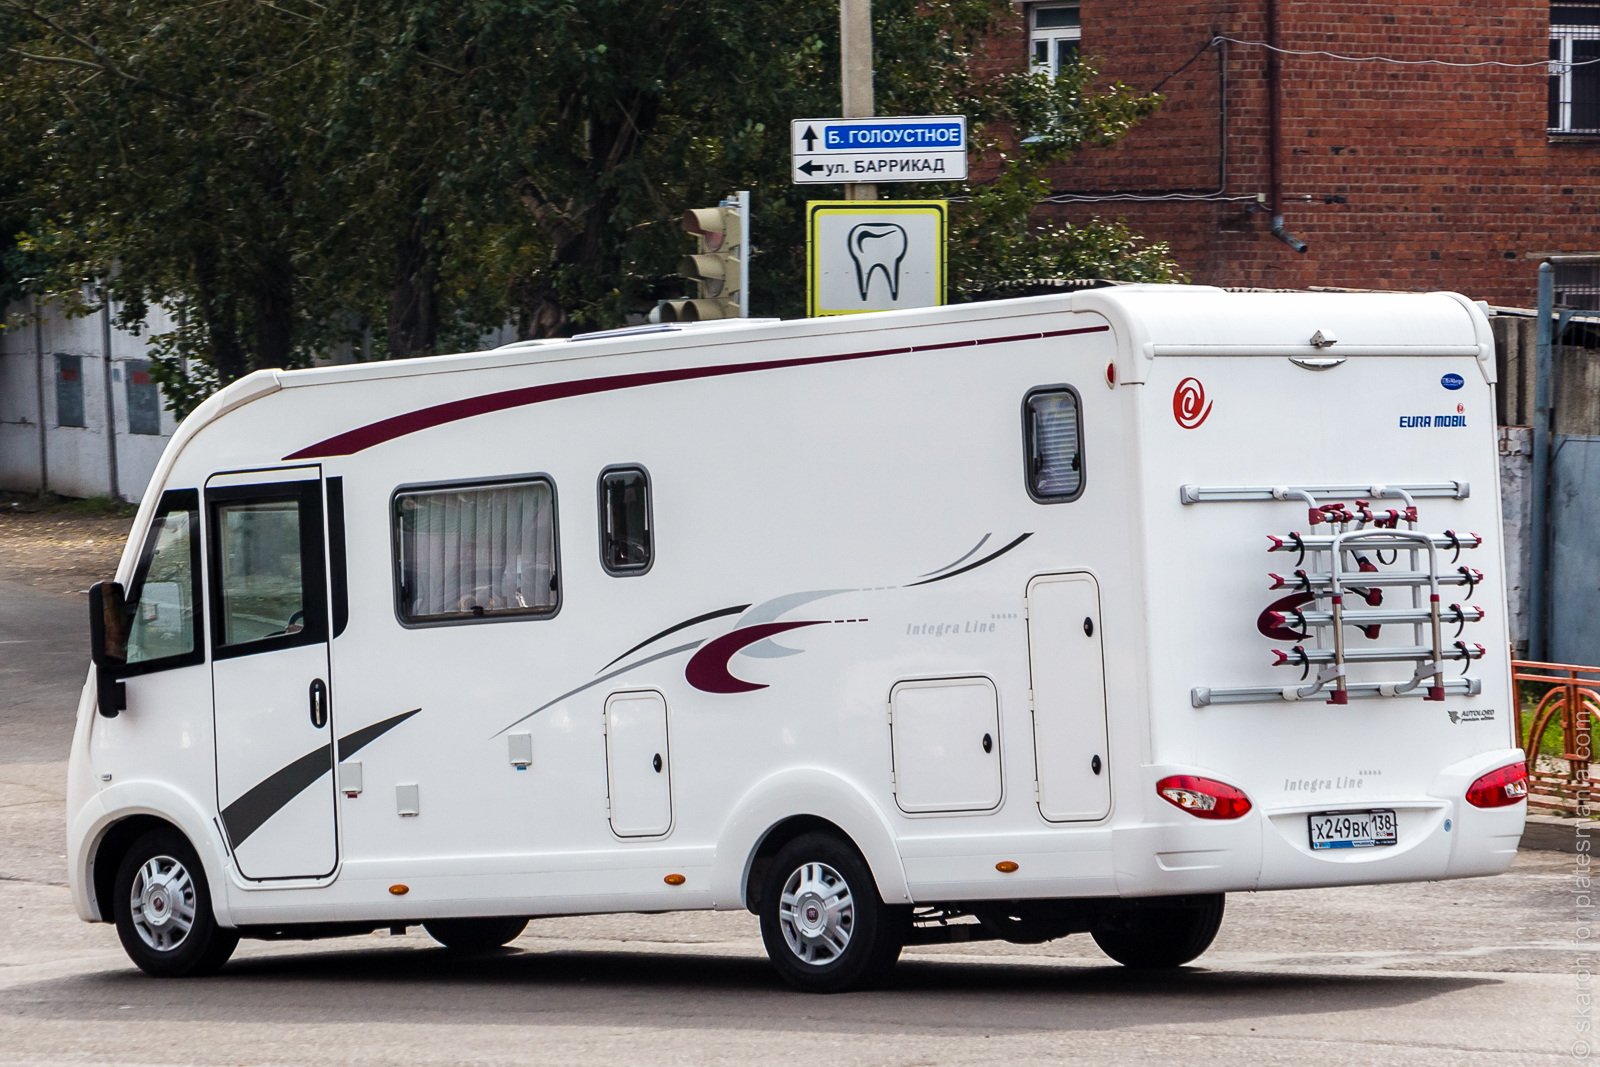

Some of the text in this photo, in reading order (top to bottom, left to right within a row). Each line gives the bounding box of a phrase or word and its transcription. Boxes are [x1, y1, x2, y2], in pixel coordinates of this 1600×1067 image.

[828, 128, 960, 144] Б. ГОЛОУСТНОЕ
[826, 158, 945, 177] ул. БАРРИКАД
[1399, 415, 1467, 428] EURA MOBIL
[906, 620, 996, 637] Integra Line
[1461, 709, 1495, 717] AUTOLORD
[1284, 776, 1363, 793] Integra Line
[1371, 815, 1391, 831] 138
